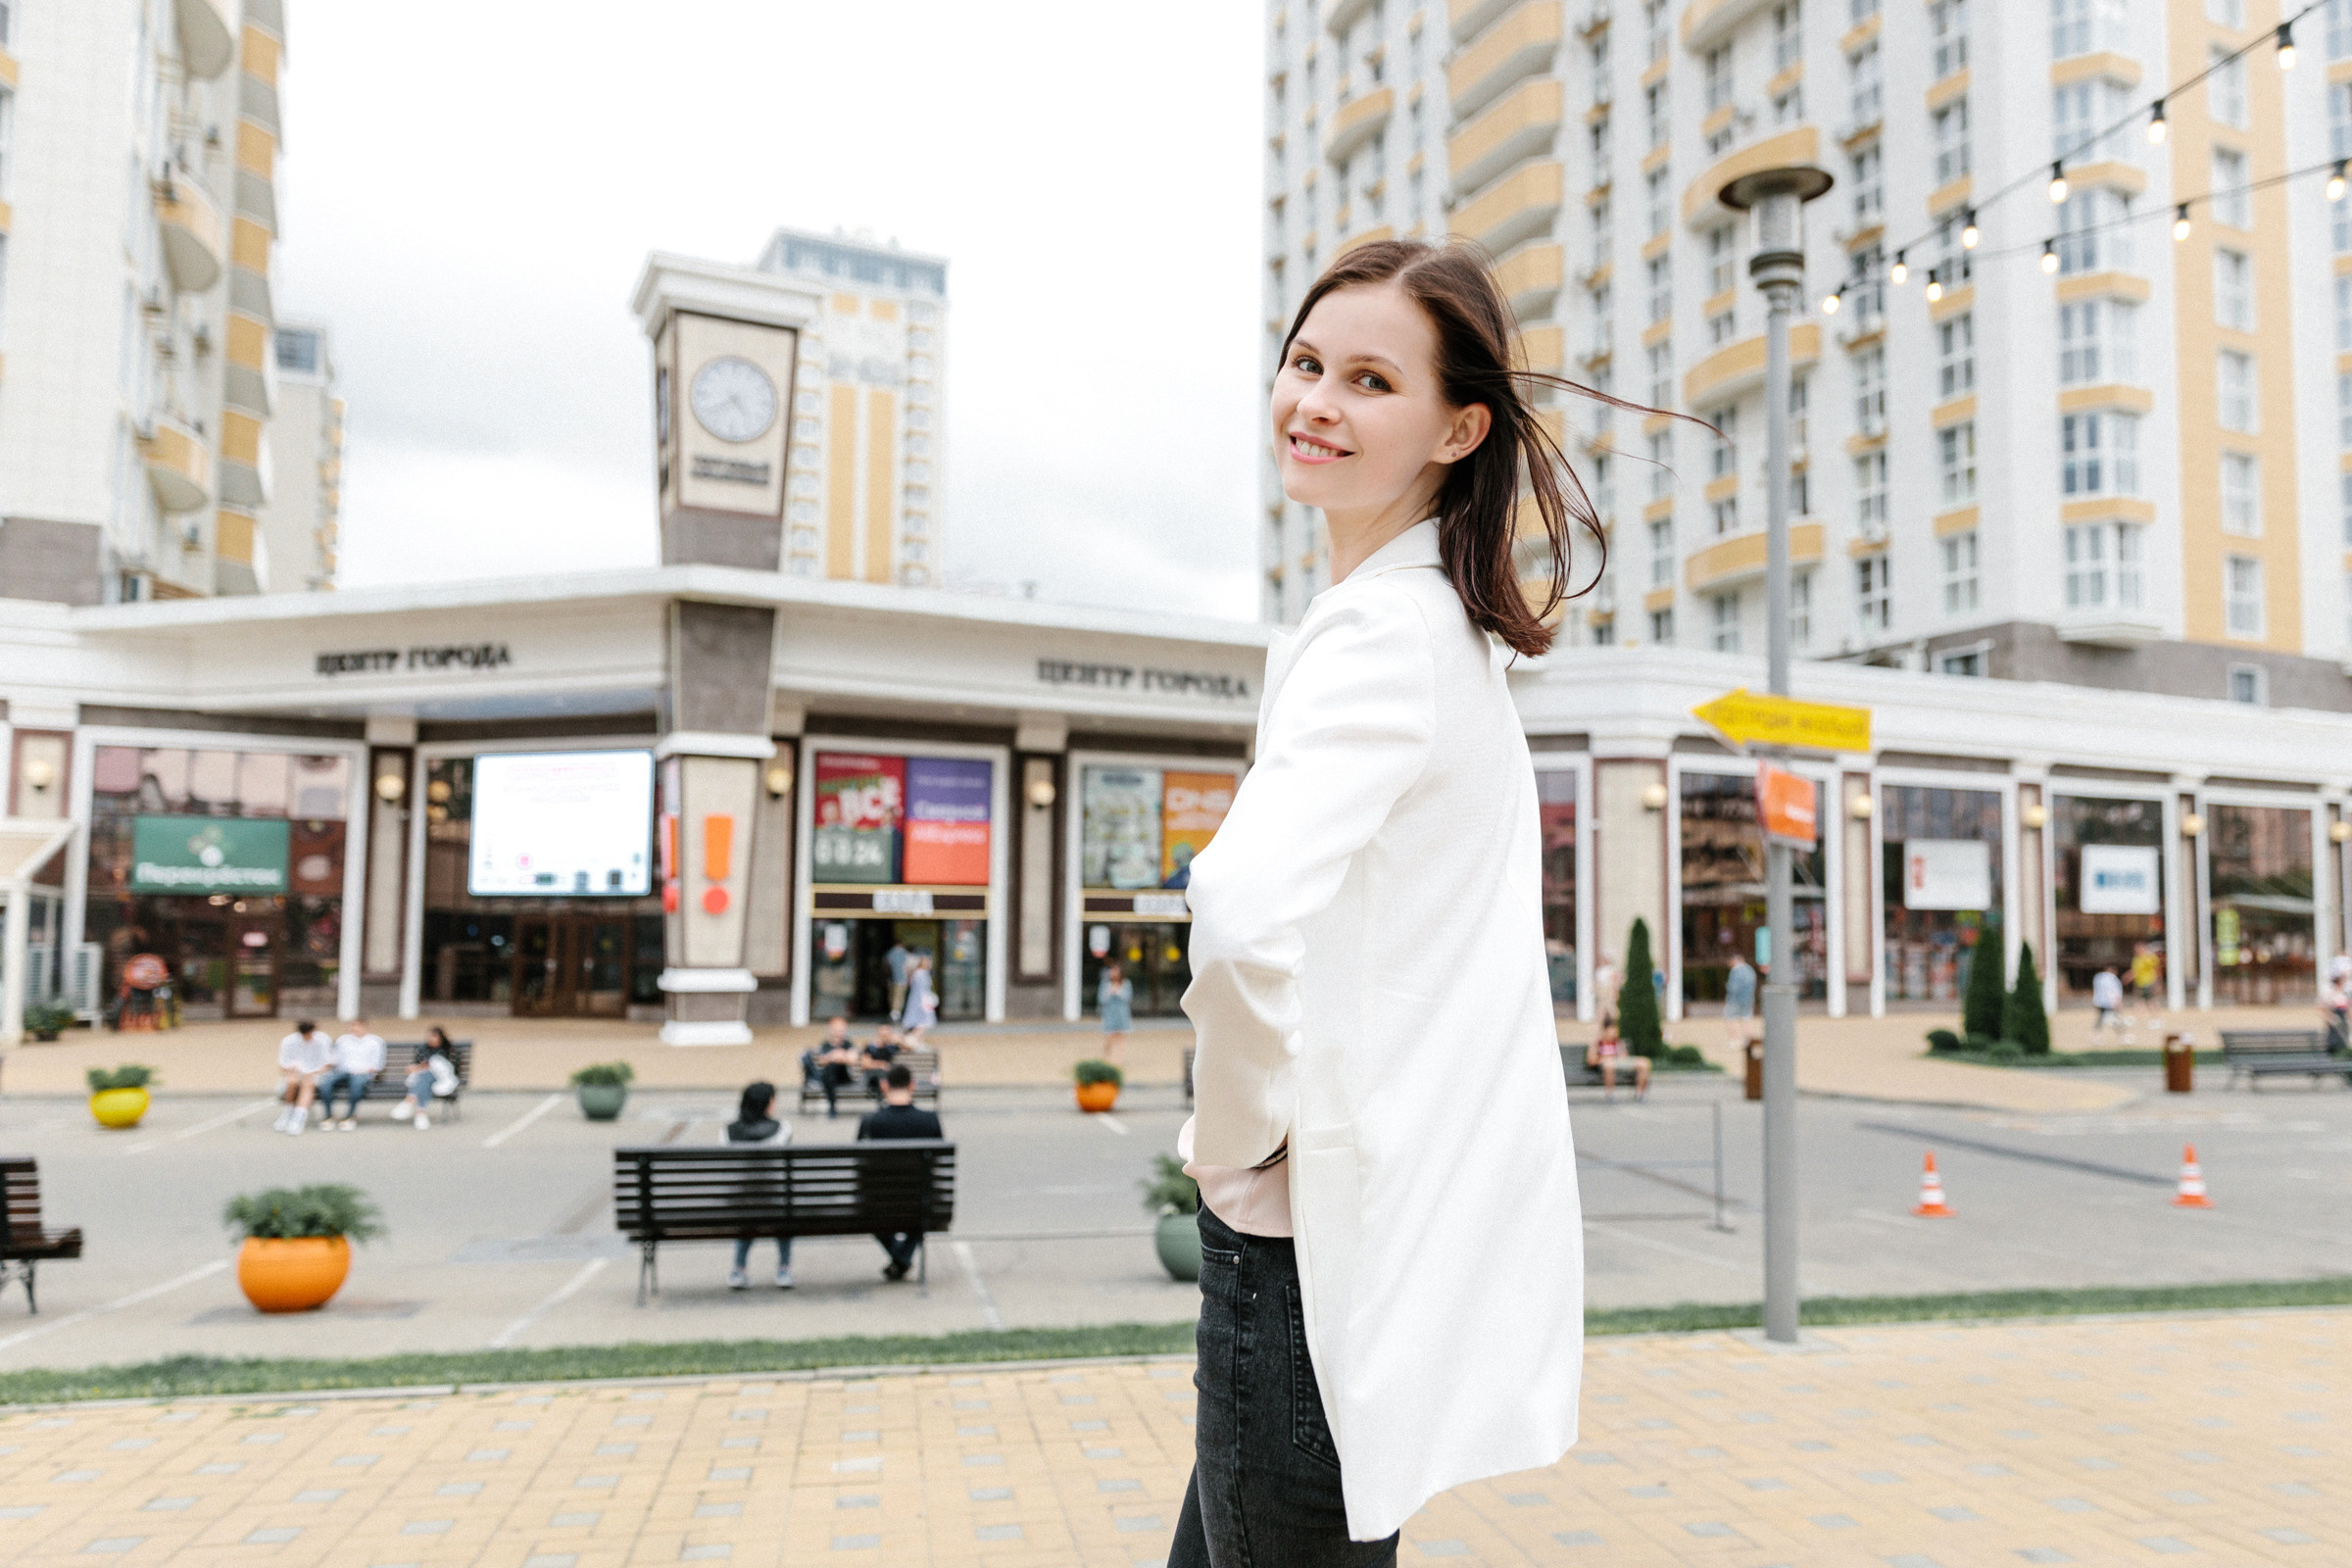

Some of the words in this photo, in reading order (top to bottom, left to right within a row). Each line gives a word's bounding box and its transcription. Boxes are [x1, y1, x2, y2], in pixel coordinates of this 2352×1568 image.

[316, 649, 399, 676] ЦЕНТР
[409, 642, 511, 670] ГОРОДА
[1037, 658, 1134, 685] ЦЕНТР
[1141, 668, 1248, 698] ГОРОДА
